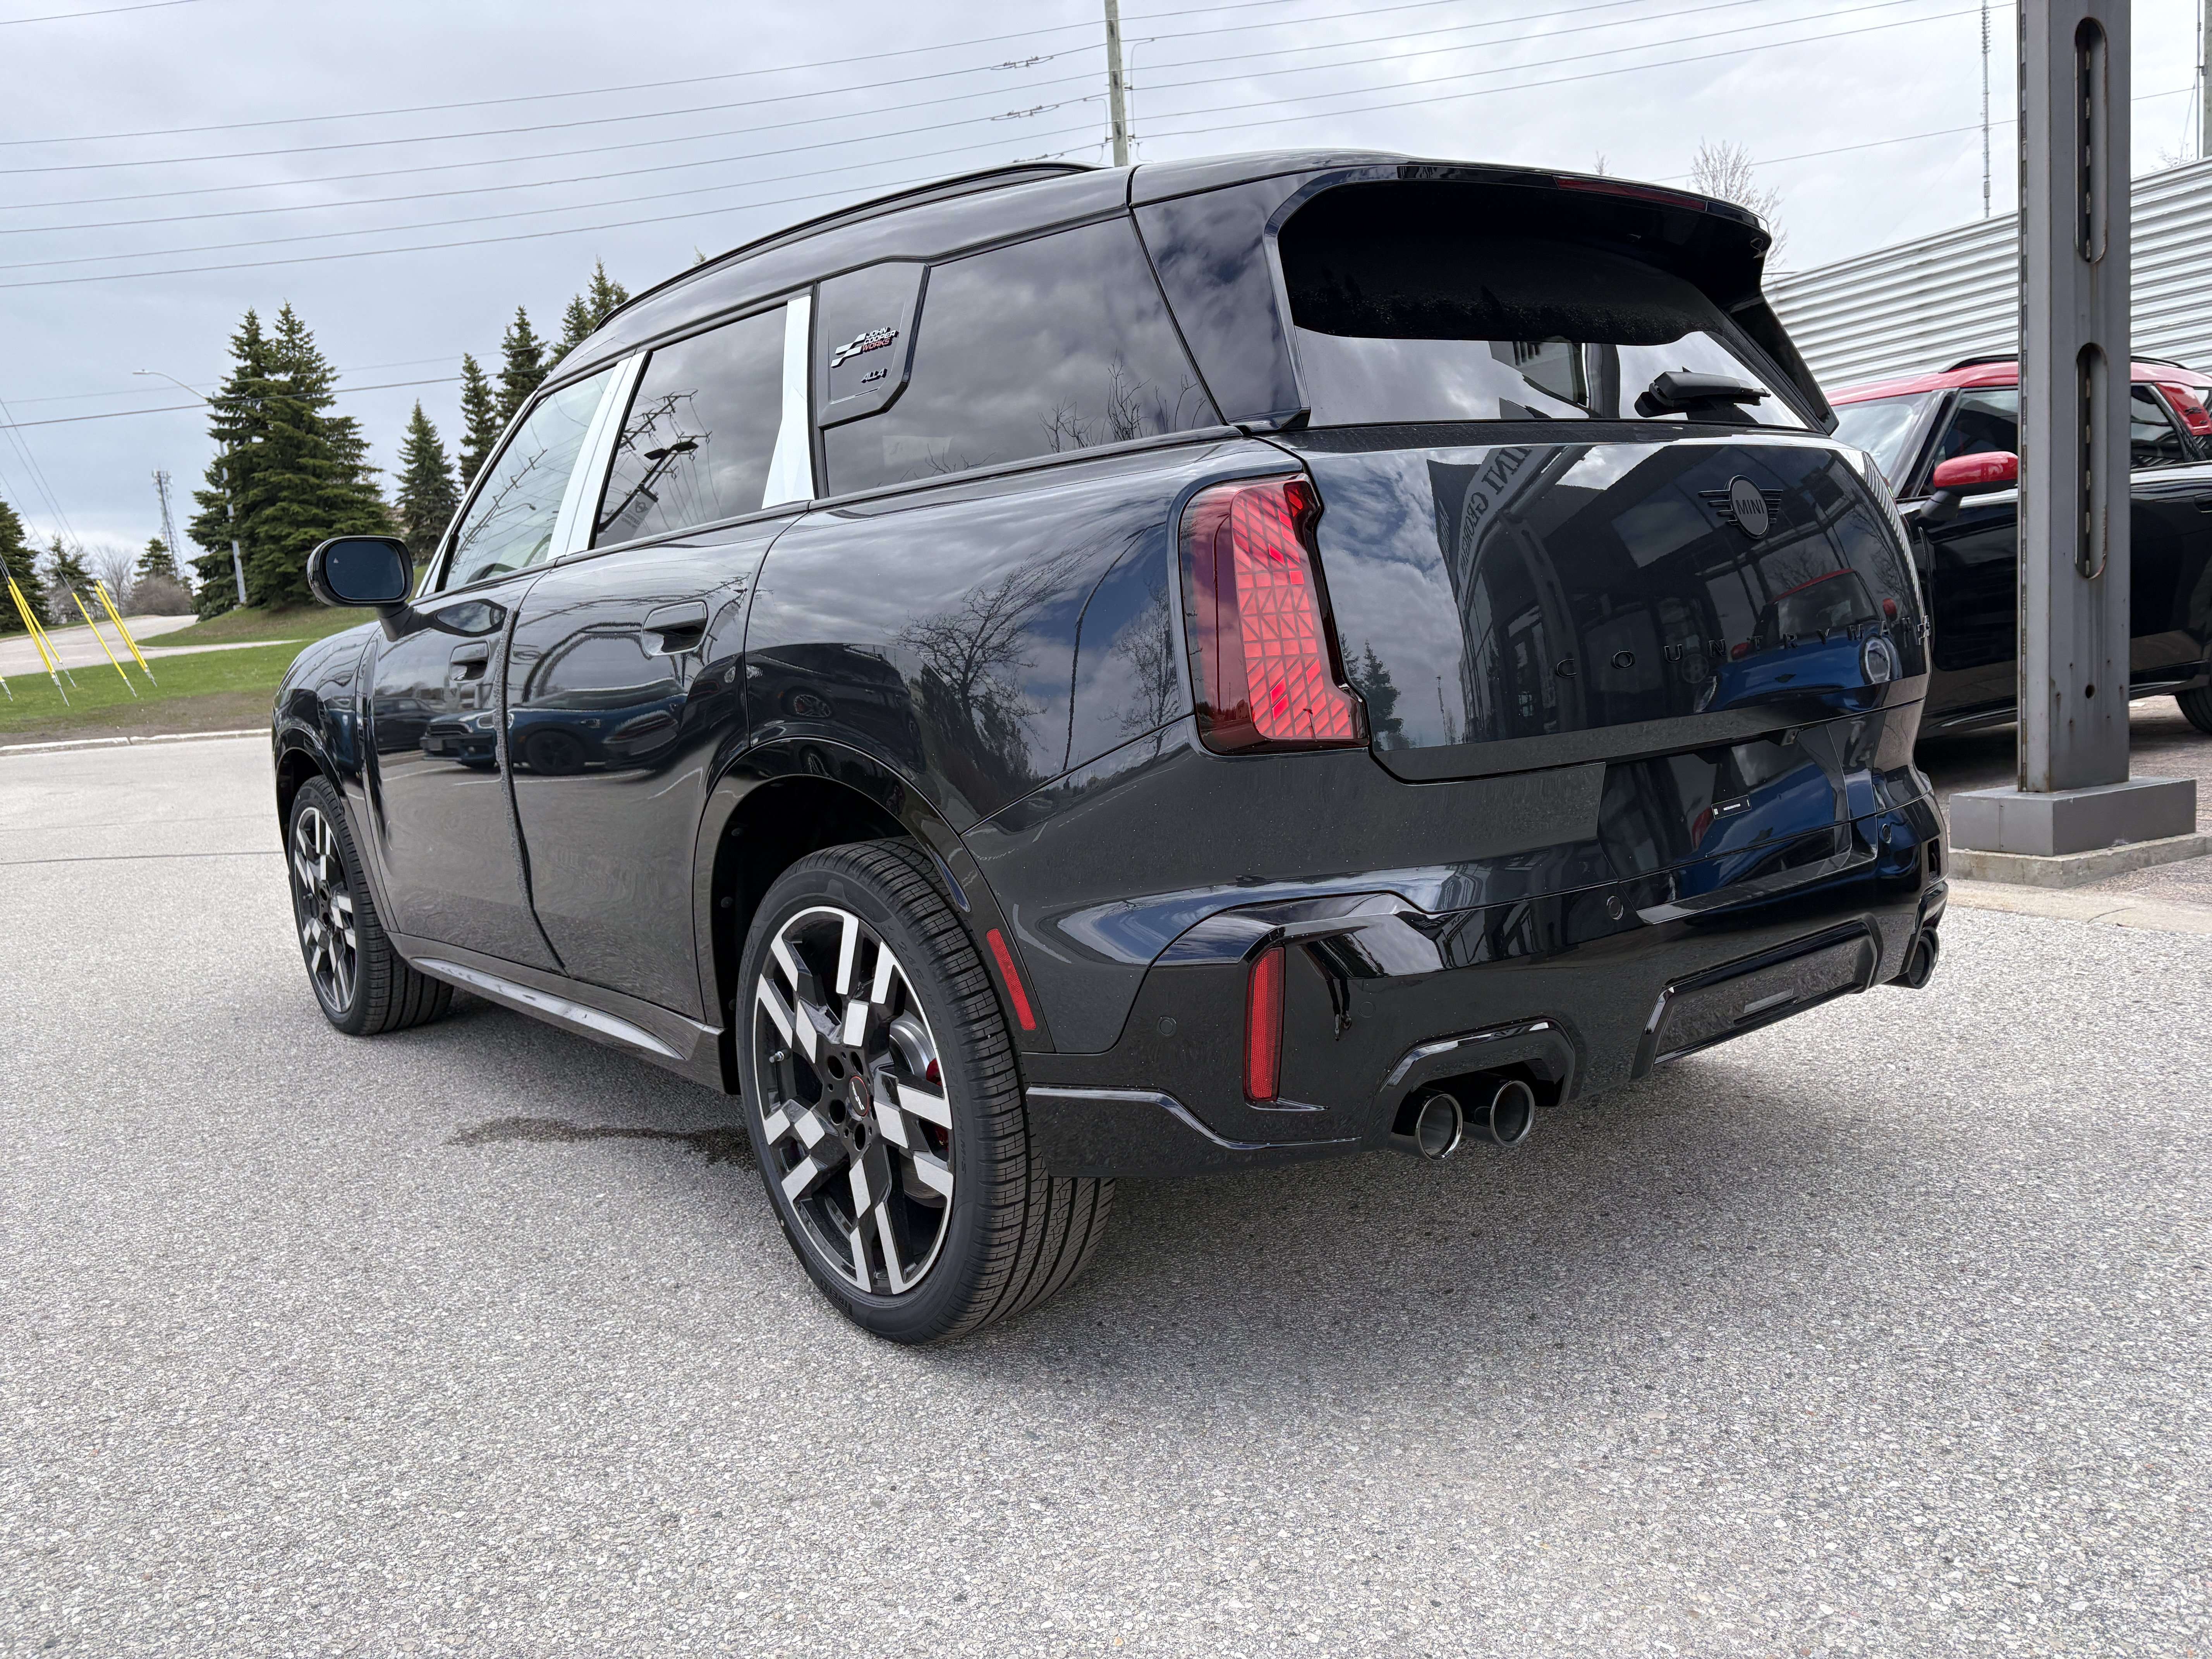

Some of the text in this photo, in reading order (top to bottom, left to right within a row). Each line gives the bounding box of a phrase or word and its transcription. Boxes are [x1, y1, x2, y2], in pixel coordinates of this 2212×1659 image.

[864, 330, 896, 345] COOPER
[866, 327, 888, 338] JOHN
[862, 338, 891, 351] WORKS
[861, 368, 885, 382] ALL4
[1736, 499, 1764, 515] MINI
[820, 1278, 853, 1317] PIRELLI
